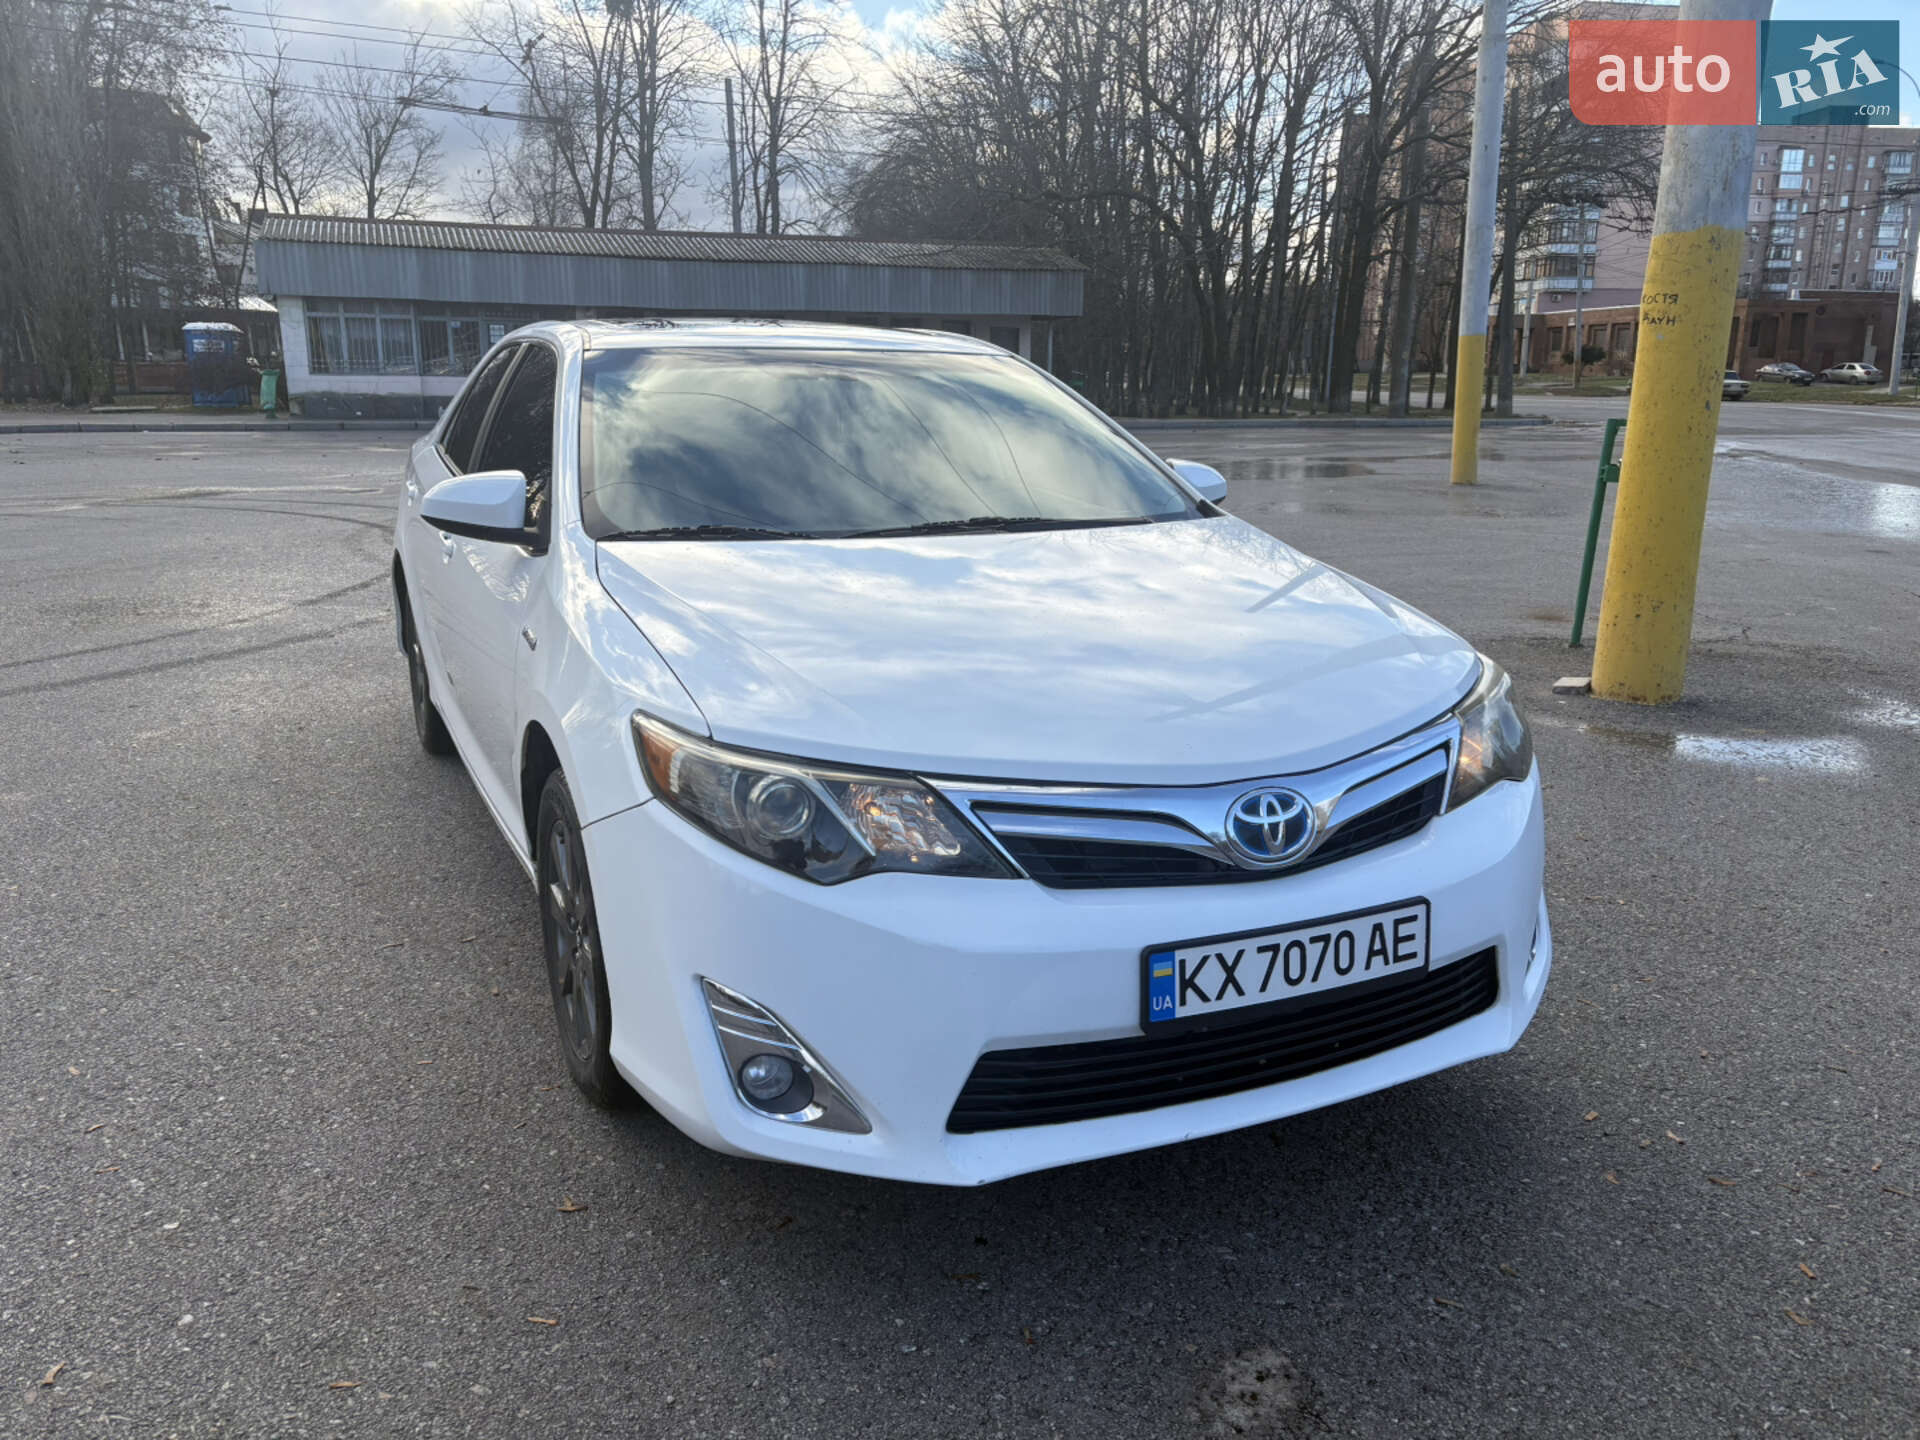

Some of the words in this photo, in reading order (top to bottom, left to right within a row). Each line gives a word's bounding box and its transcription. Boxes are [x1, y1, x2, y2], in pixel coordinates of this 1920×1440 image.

[1179, 949, 1246, 1007] KX
[1257, 930, 1355, 992] 7070
[1365, 915, 1418, 970] AE
[1153, 995, 1173, 1011] UA
